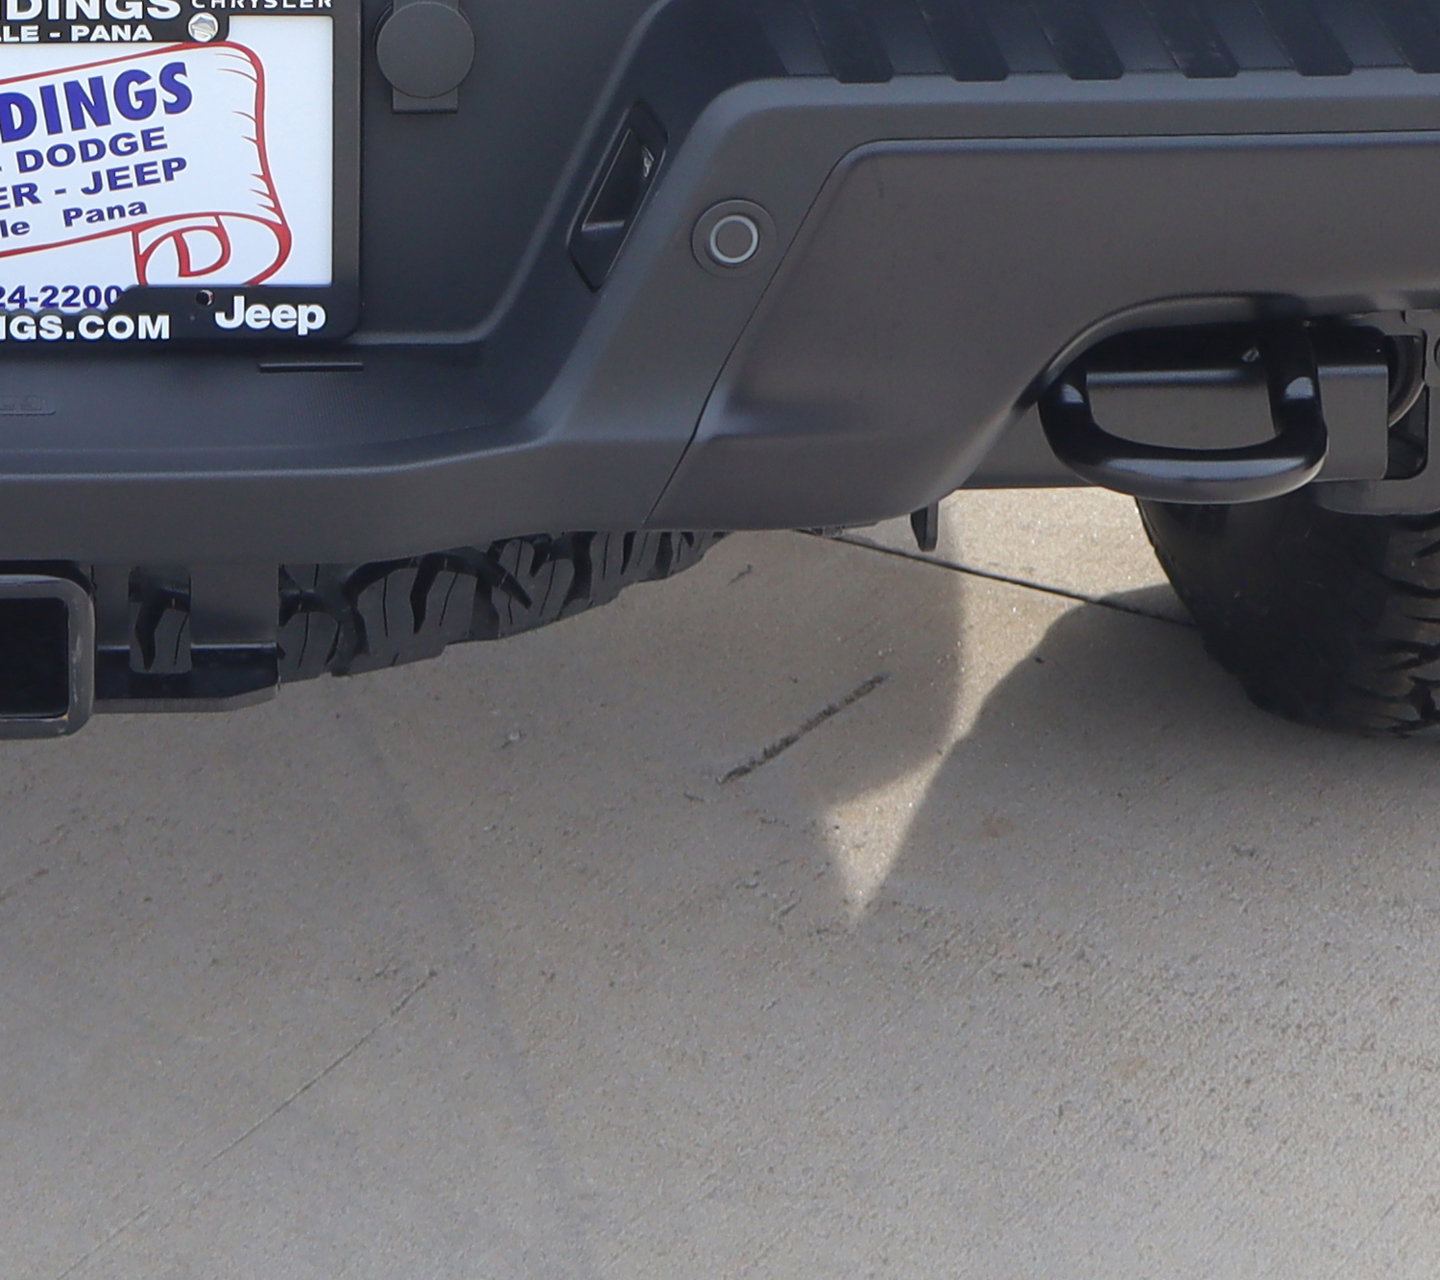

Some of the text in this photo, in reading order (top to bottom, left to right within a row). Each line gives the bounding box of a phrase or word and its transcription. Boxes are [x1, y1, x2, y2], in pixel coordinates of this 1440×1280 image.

[71, 24, 153, 41] PANA
[16, 126, 169, 174] DODGE
[81, 156, 189, 196] JEEP
[62, 199, 149, 228] Pana
[215, 296, 326, 336] Jeep
